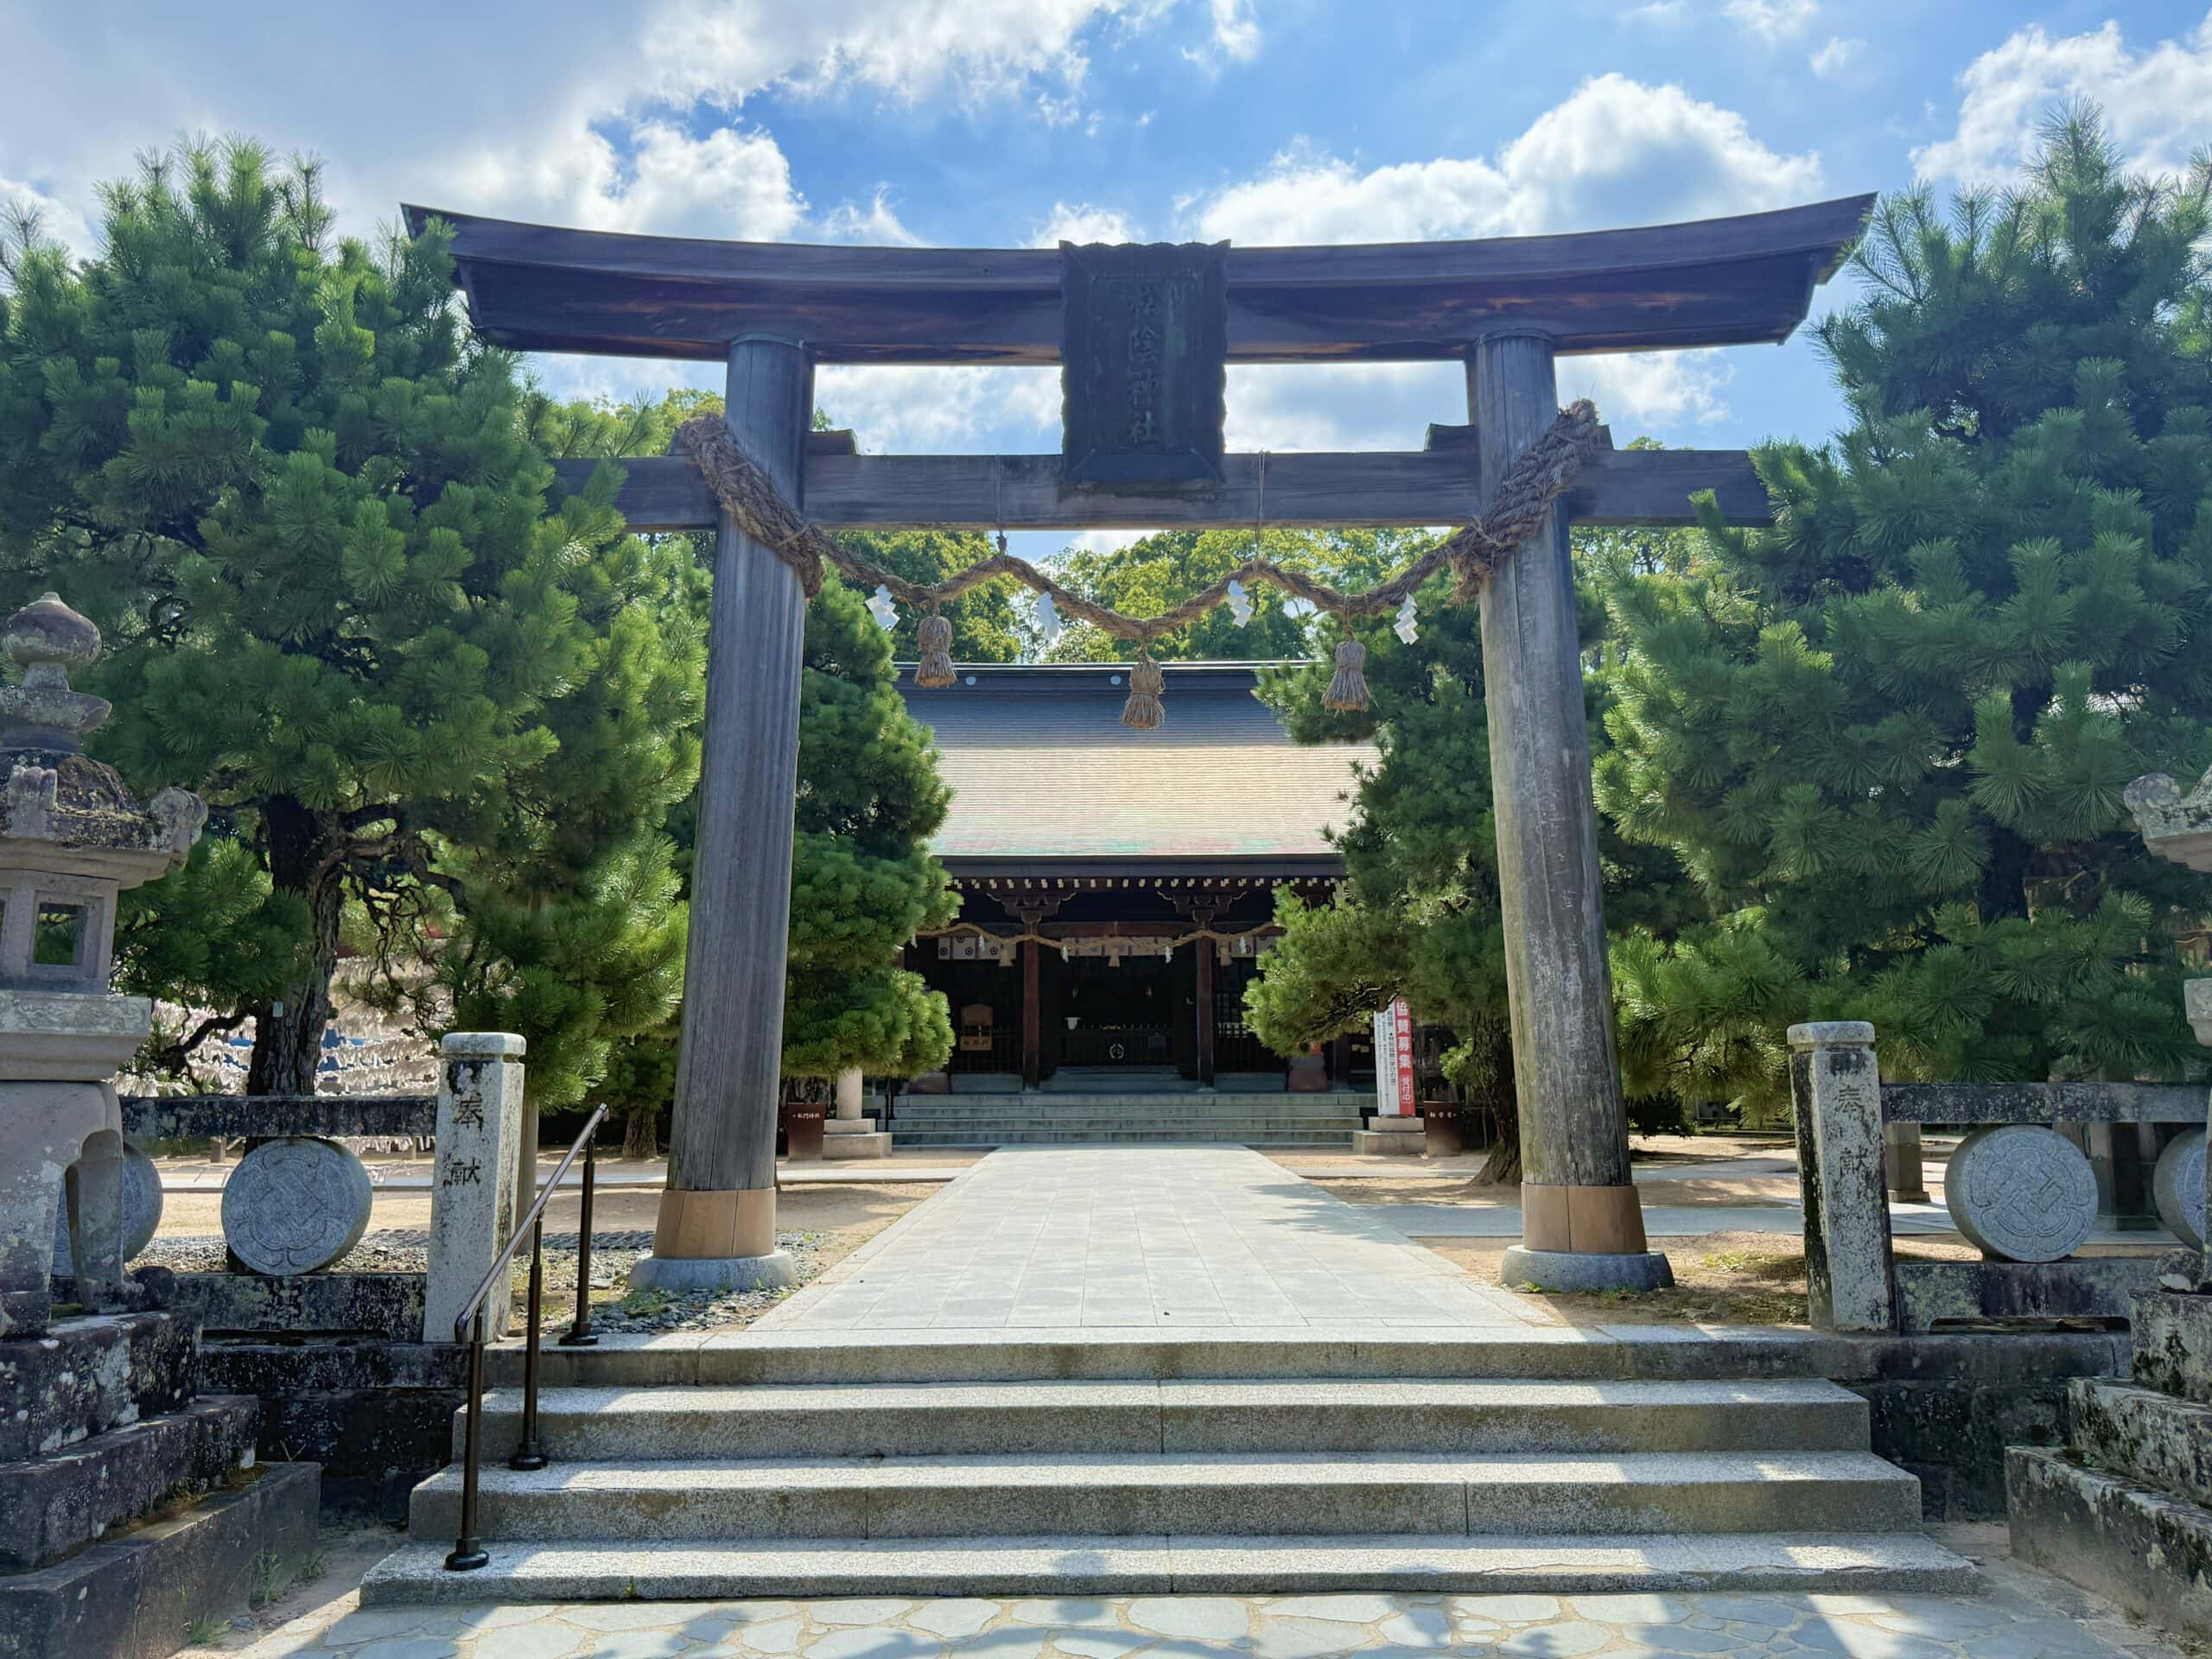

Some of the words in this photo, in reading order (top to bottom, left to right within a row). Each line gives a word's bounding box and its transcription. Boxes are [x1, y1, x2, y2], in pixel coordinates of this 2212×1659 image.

[1128, 283, 1162, 445] 松陰神社
[1395, 1001, 1412, 1070] 協賛募集
